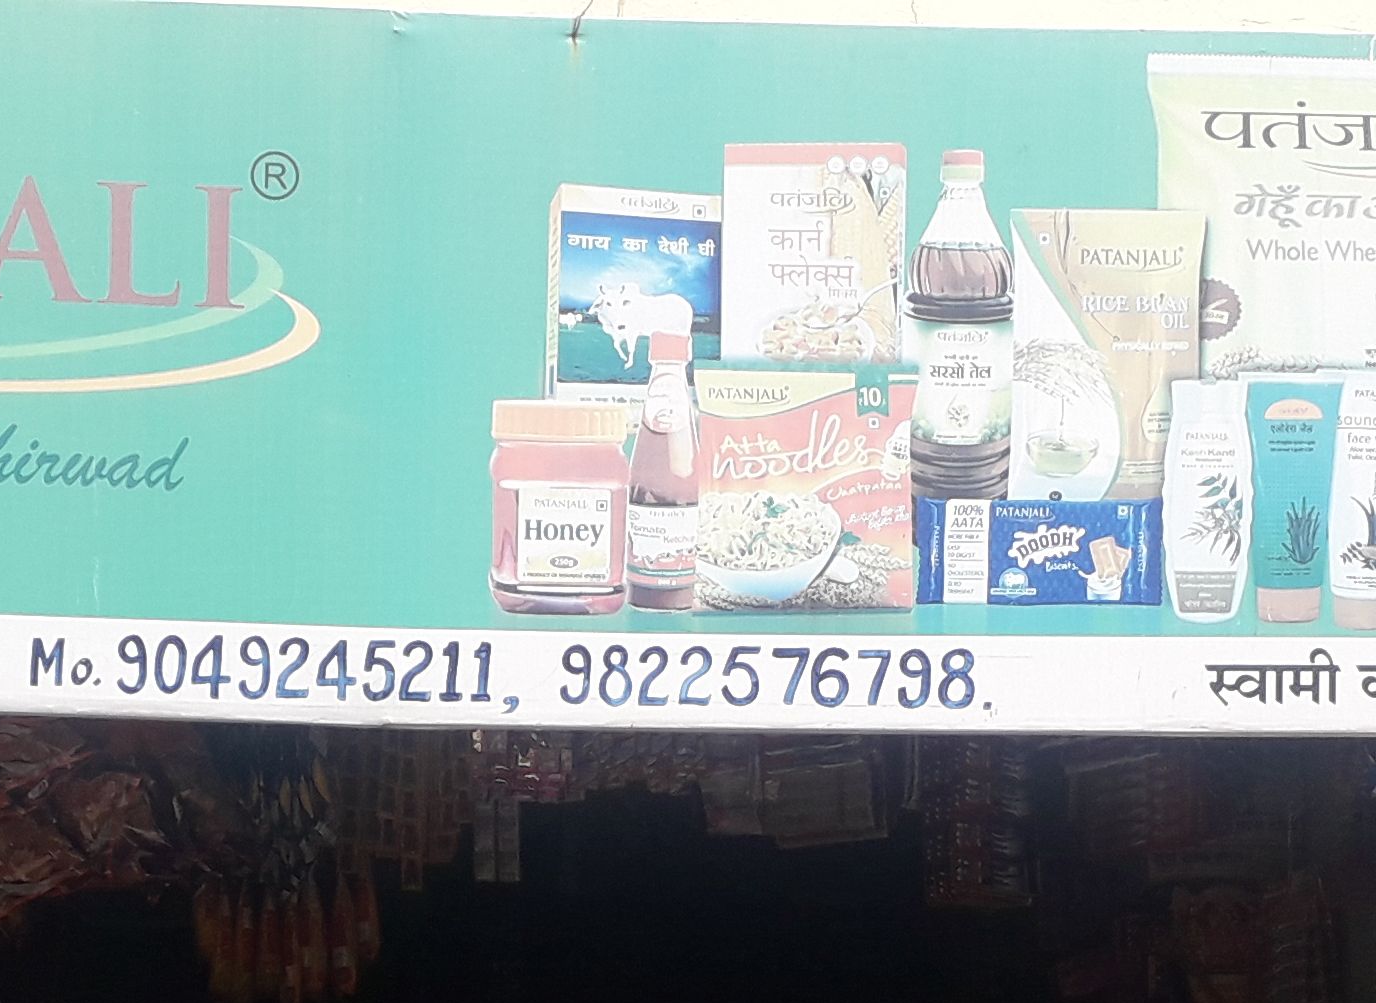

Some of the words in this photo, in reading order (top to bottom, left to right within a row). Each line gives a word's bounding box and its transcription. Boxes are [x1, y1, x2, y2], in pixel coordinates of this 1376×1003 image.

[1305, 193, 1363, 219] का
[622, 236, 648, 253] का
[1246, 239, 1319, 262] Whole
[1082, 295, 1130, 313] RICE
[1160, 314, 1191, 330] OIL
[969, 362, 992, 379] तेल
[720, 433, 782, 454] Atta
[1347, 432, 1372, 445] face
[523, 518, 604, 547] Honey
[951, 517, 984, 529] AATA
[1015, 530, 1075, 560] DOODH
[1206, 648, 1341, 705] स्वामी
